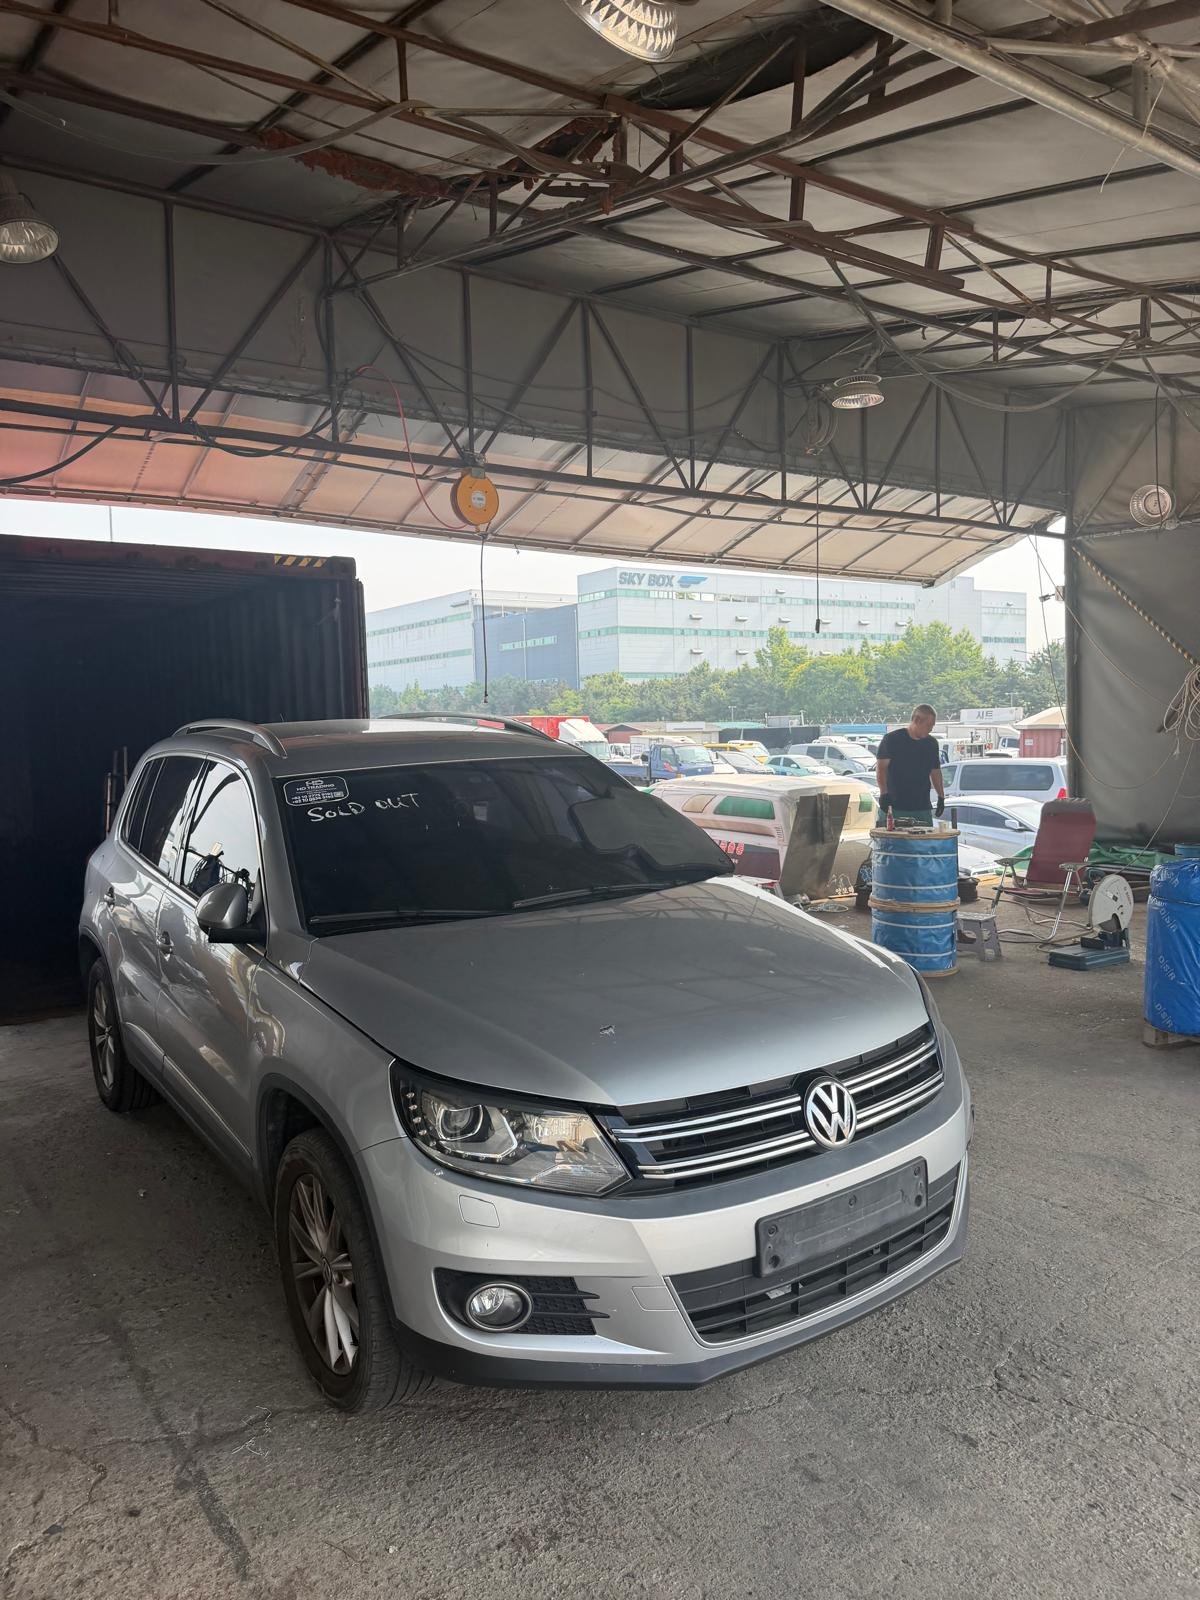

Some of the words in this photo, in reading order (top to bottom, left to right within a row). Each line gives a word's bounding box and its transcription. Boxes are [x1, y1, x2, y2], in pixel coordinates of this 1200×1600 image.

[618, 571, 646, 585] SKY
[648, 573, 675, 587] BOX
[307, 802, 365, 822] SOLD
[374, 792, 420, 809] OUT
